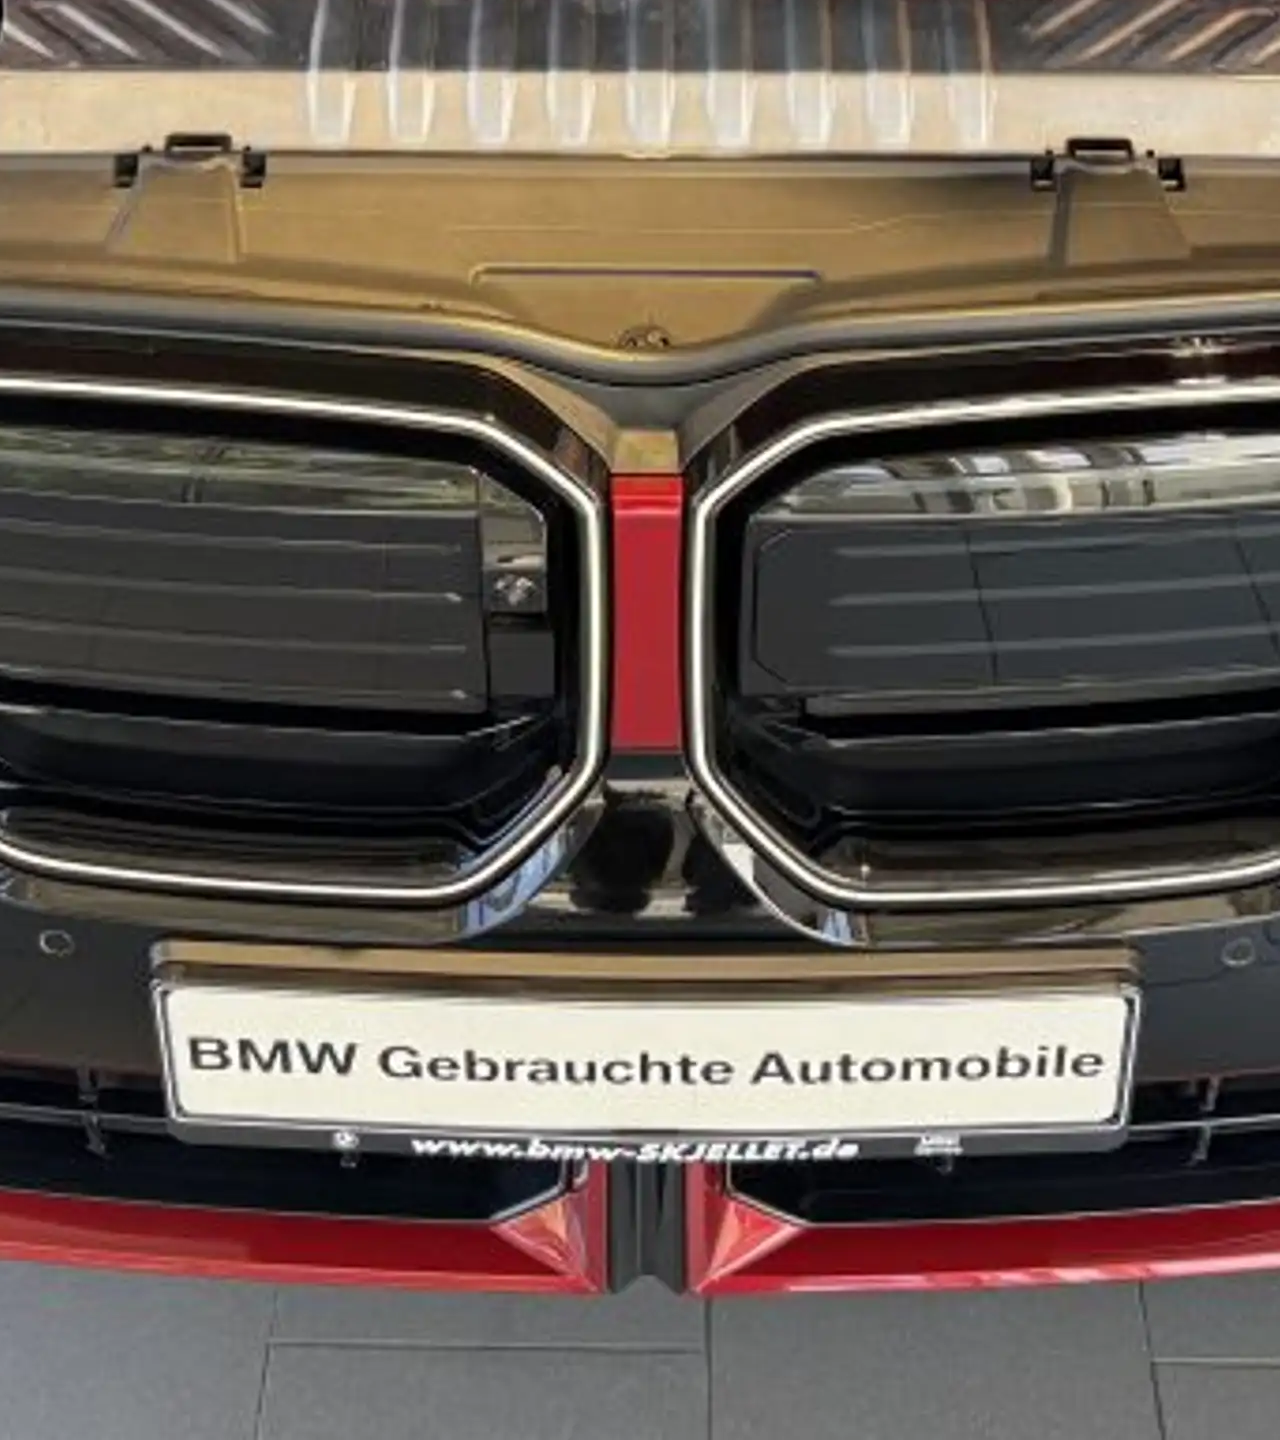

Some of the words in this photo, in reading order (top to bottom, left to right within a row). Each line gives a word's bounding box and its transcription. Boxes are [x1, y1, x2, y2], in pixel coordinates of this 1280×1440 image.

[189, 1037, 358, 1076] BMW
[377, 1046, 735, 1085] Gebrauchte
[750, 1045, 1105, 1085] Automobile
